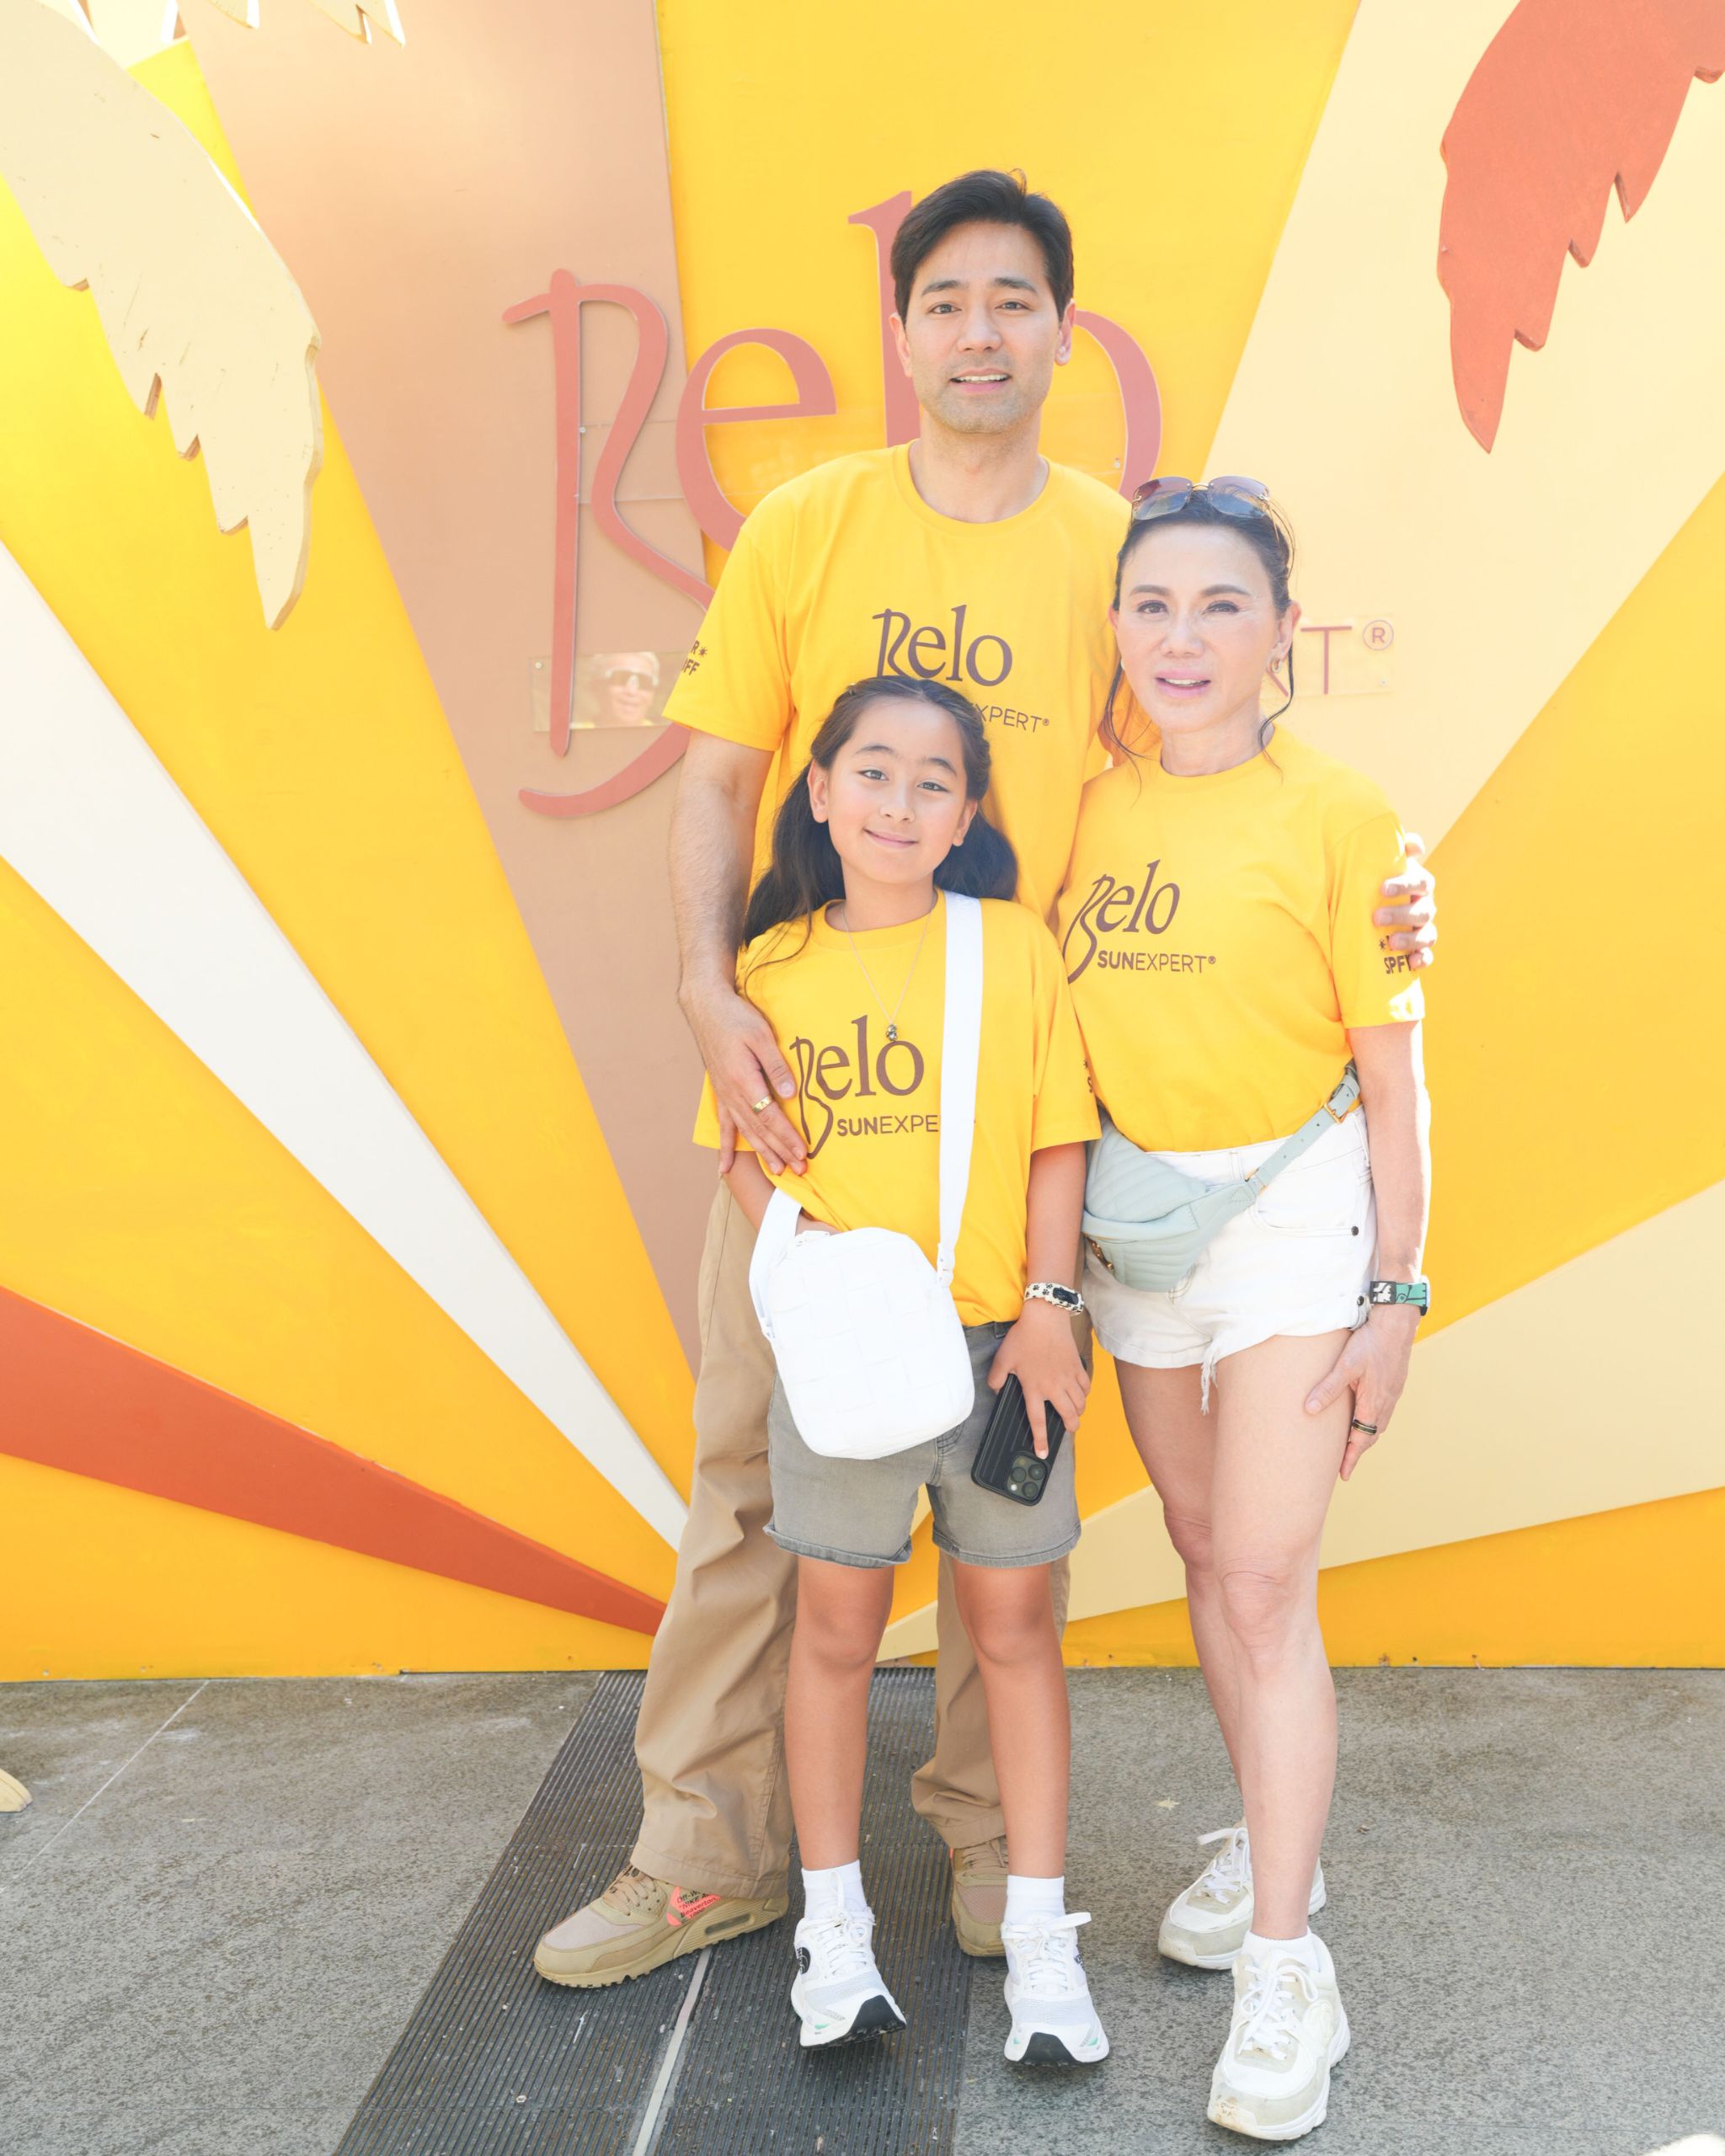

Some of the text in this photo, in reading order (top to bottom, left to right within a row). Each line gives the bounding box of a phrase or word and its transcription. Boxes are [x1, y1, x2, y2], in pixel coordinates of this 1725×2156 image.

[681, 658, 701, 675] FF
[971, 702, 1049, 733] XPERT®
[1062, 859, 1180, 985] Belo
[789, 1014, 925, 1160] Belo
[836, 1114, 940, 1137] SUNEXPE
